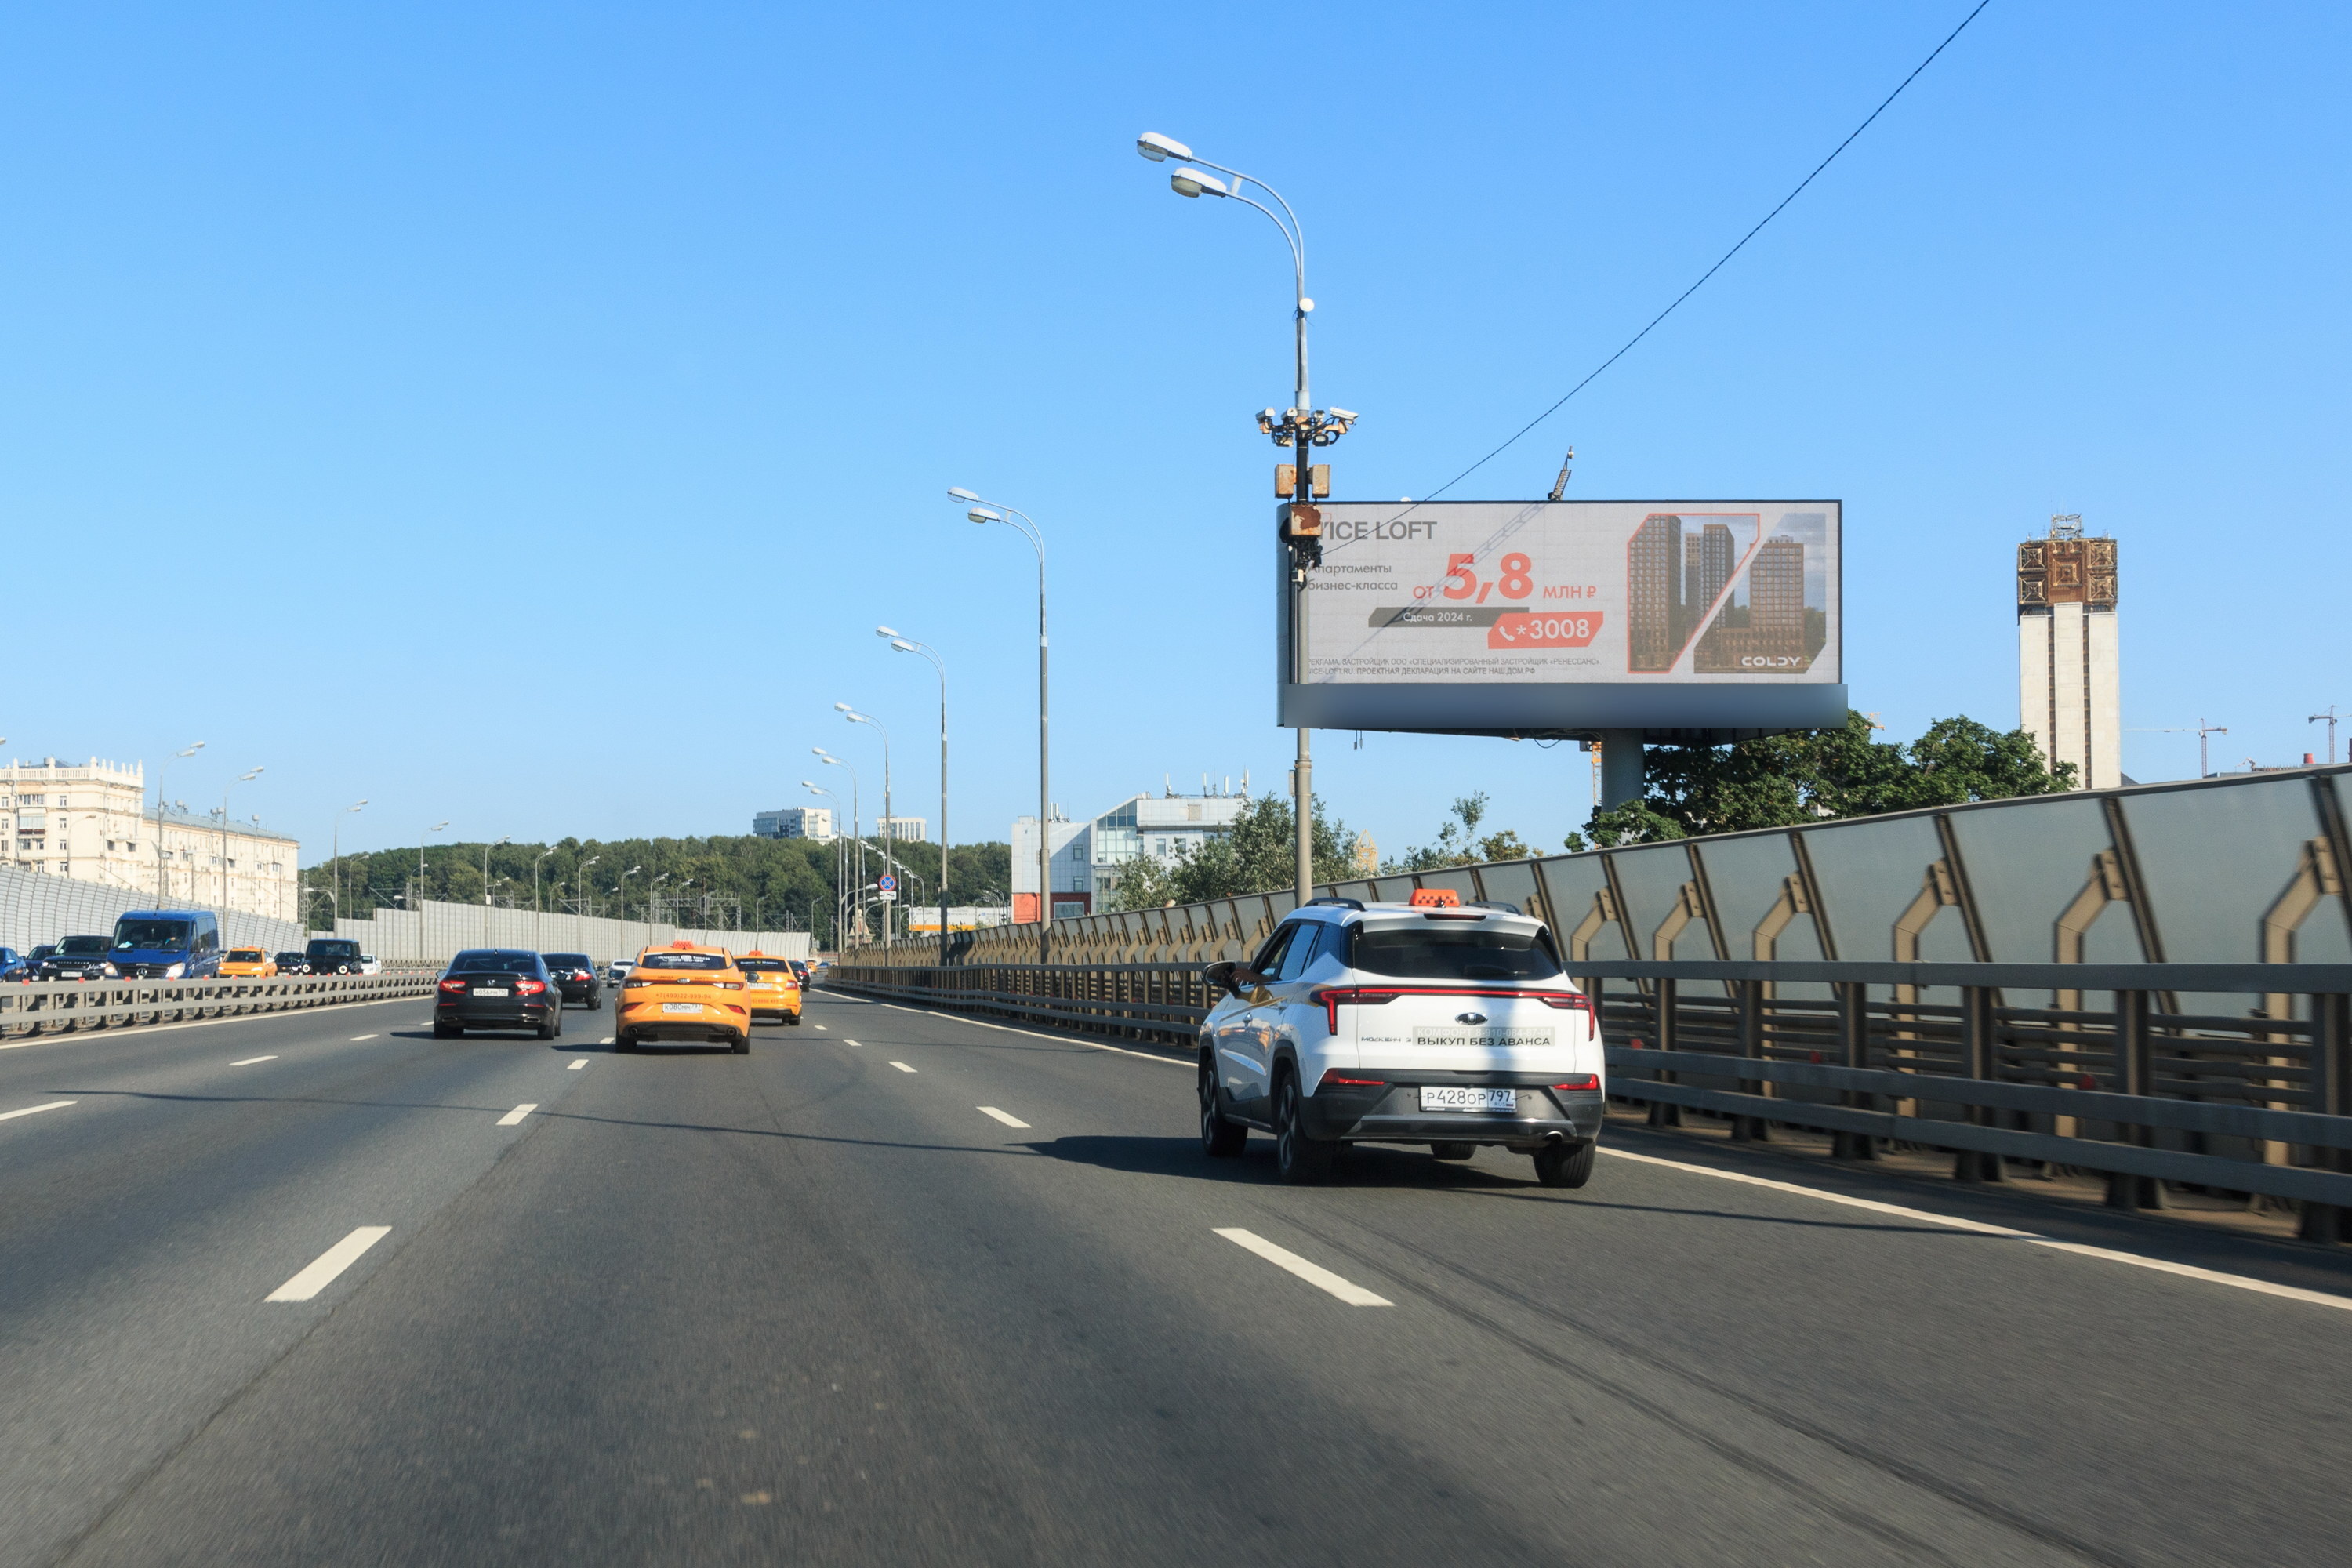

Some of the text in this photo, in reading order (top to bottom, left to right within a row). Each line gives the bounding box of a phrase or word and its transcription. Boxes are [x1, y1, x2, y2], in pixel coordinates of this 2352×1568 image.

[1376, 521, 1437, 540] LOFT
[1443, 552, 1534, 604] 5,8
[1543, 586, 1583, 599] МЛН
[1308, 578, 1398, 590] бизнес-класса
[1403, 612, 1435, 623] Сдача
[1437, 612, 1463, 622] 2024
[1342, 658, 1389, 666] ЗАСТРОЙЩИК
[1501, 657, 1548, 666] ЗАСТРОЙЩИК
[1401, 667, 1449, 676] ДЕКЛАРАЦИЯ
[1463, 666, 1487, 675] САЙТЕ
[1417, 1027, 1552, 1037] КОМФОРТ 8-910-084-87-04
[1417, 1037, 1551, 1046] ВЫКУП БЕЗ АВАНСА
